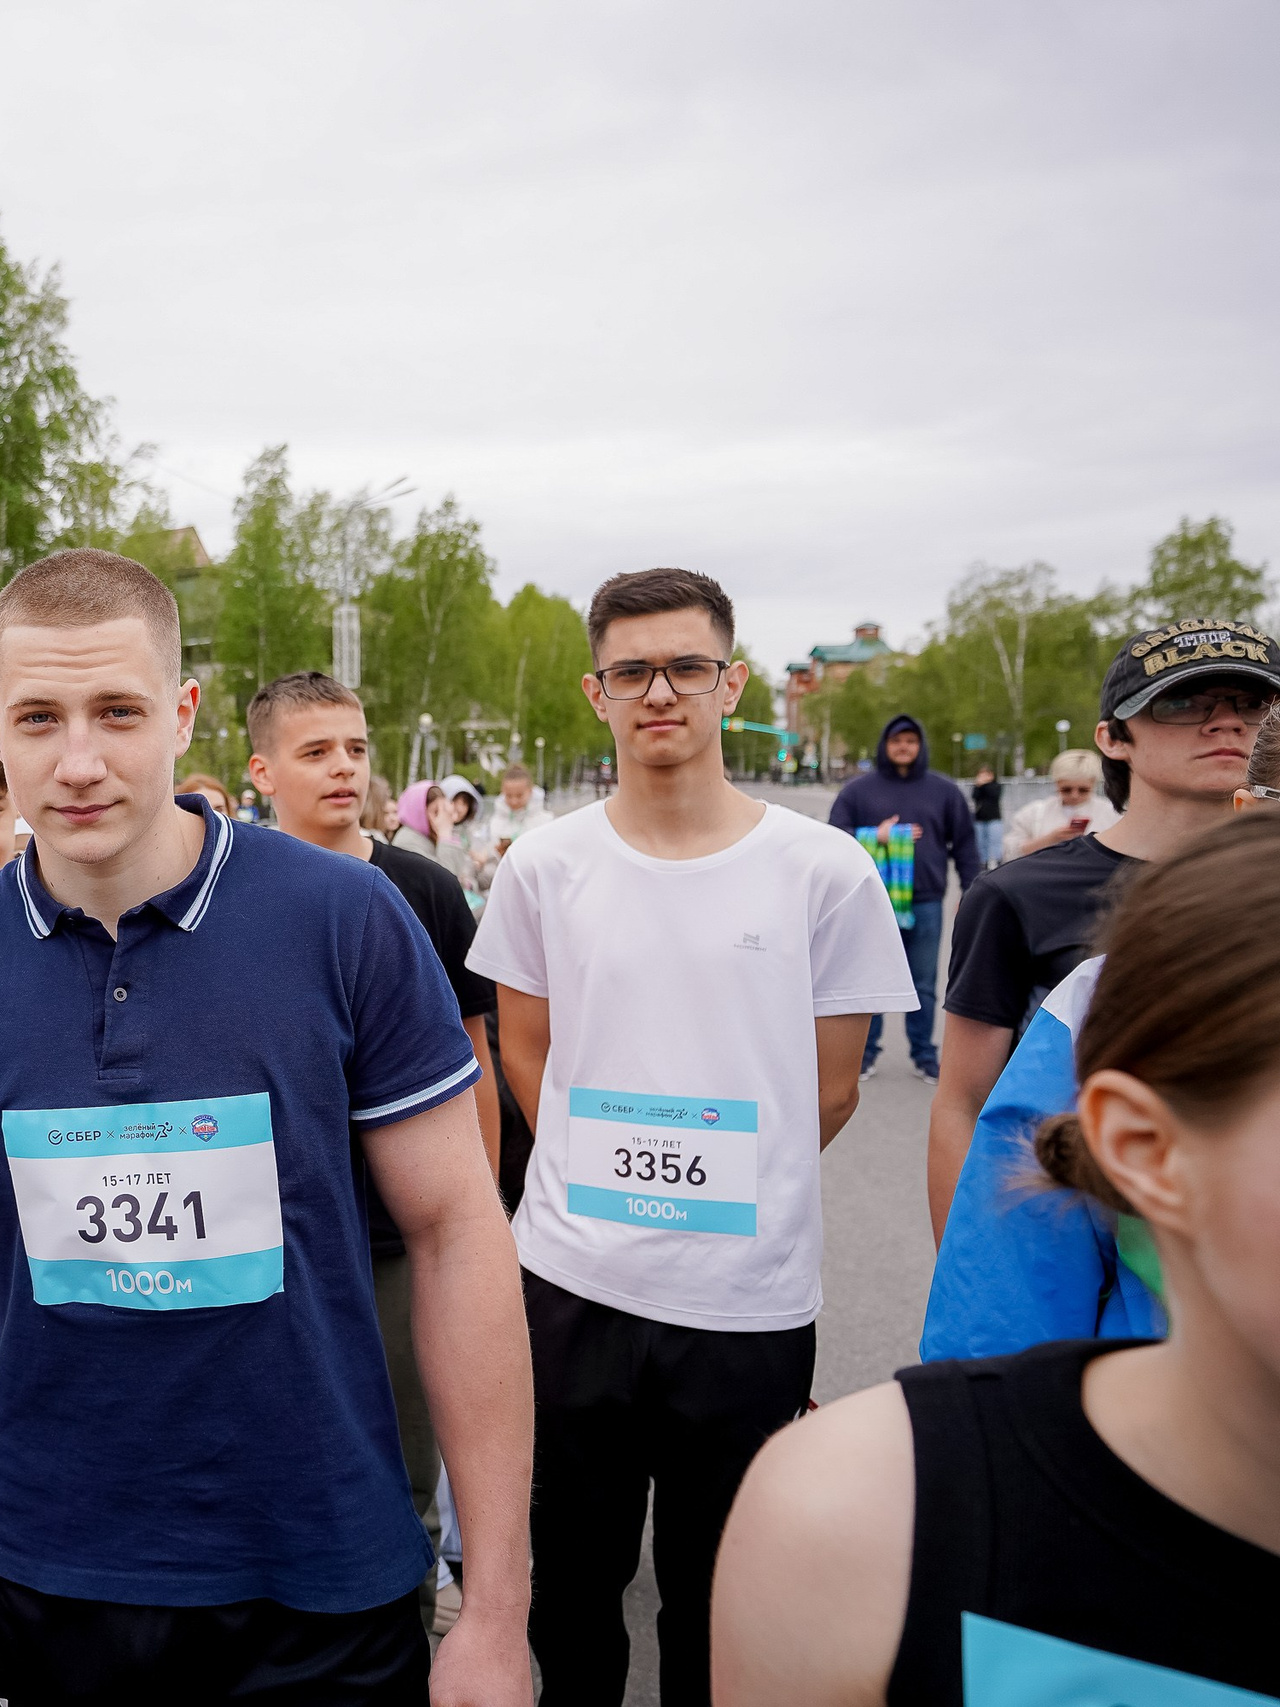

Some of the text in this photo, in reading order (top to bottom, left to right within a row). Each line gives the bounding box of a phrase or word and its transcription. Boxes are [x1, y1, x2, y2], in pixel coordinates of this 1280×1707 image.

[1143, 640, 1269, 677] BLACK
[612, 1105, 634, 1114] СБЕР
[123, 1123, 156, 1131] зелёный
[66, 1131, 102, 1142] СБЕР
[119, 1131, 155, 1141] марафон
[631, 1137, 683, 1149] 15-17 ЛЕТ
[614, 1148, 707, 1186] 3356
[102, 1172, 171, 1187] 15-17 ЛЕТ
[76, 1190, 207, 1244] 3341
